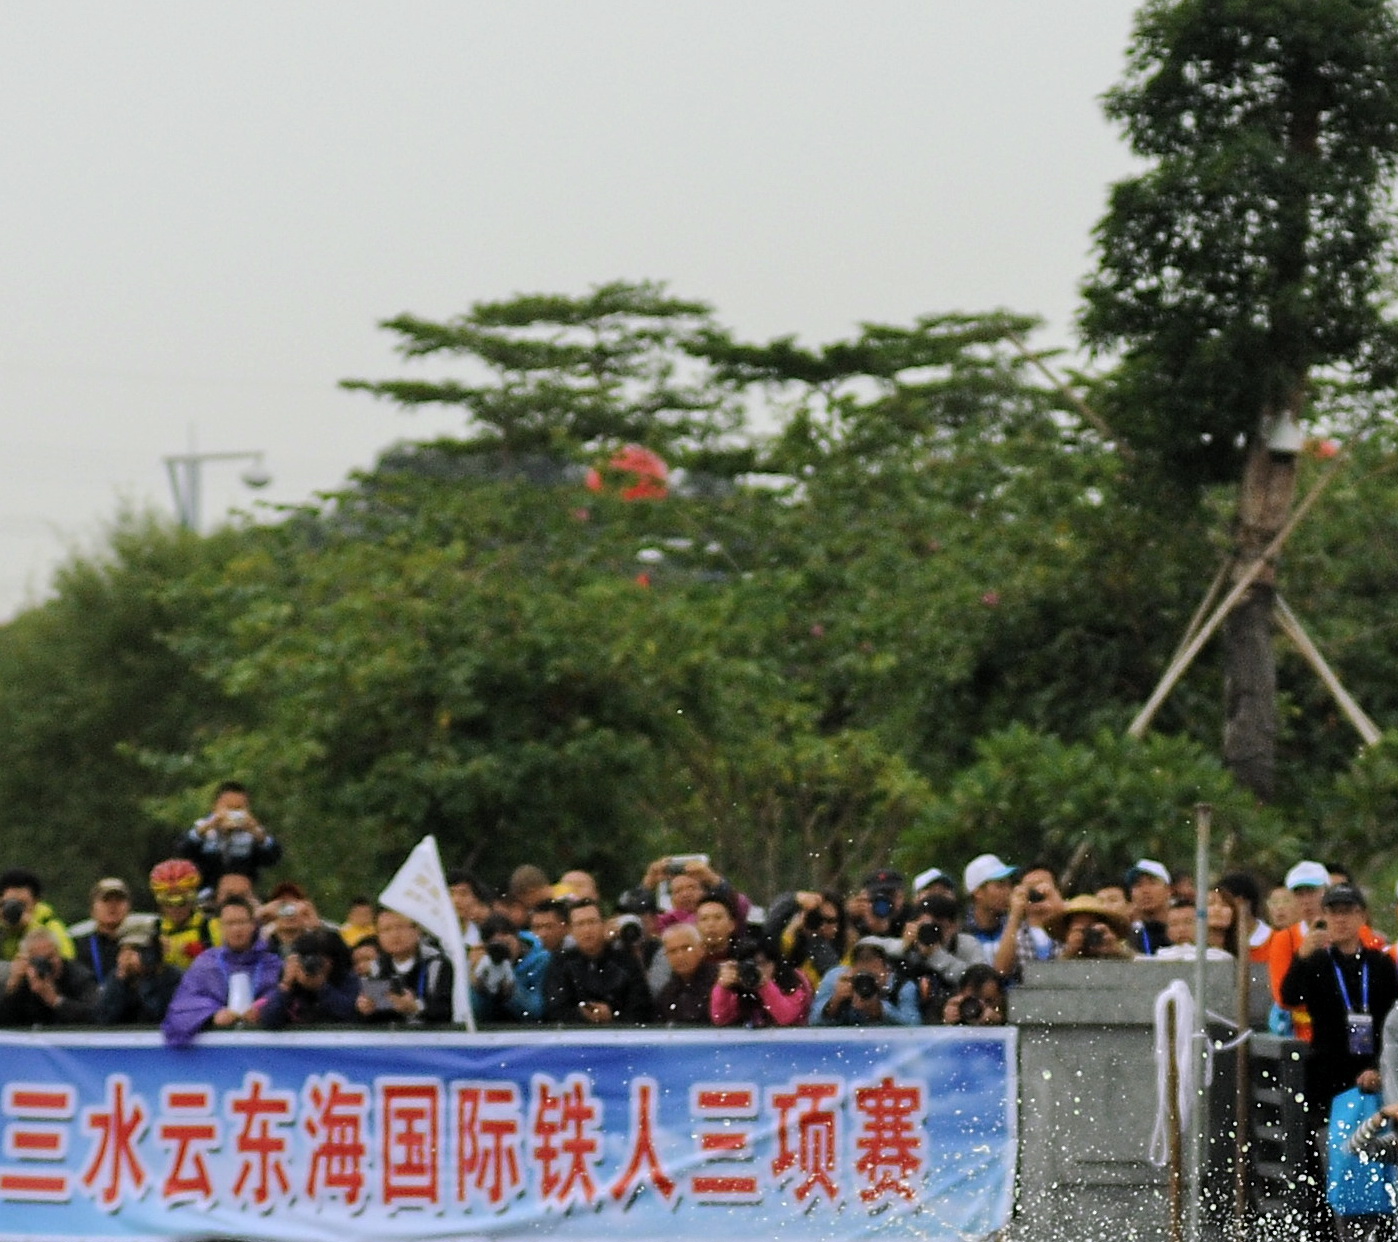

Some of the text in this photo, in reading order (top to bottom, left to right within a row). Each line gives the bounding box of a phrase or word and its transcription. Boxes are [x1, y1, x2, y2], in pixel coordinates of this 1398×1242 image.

[4, 1074, 923, 1203] 三水云东海国际铁人三项赛
